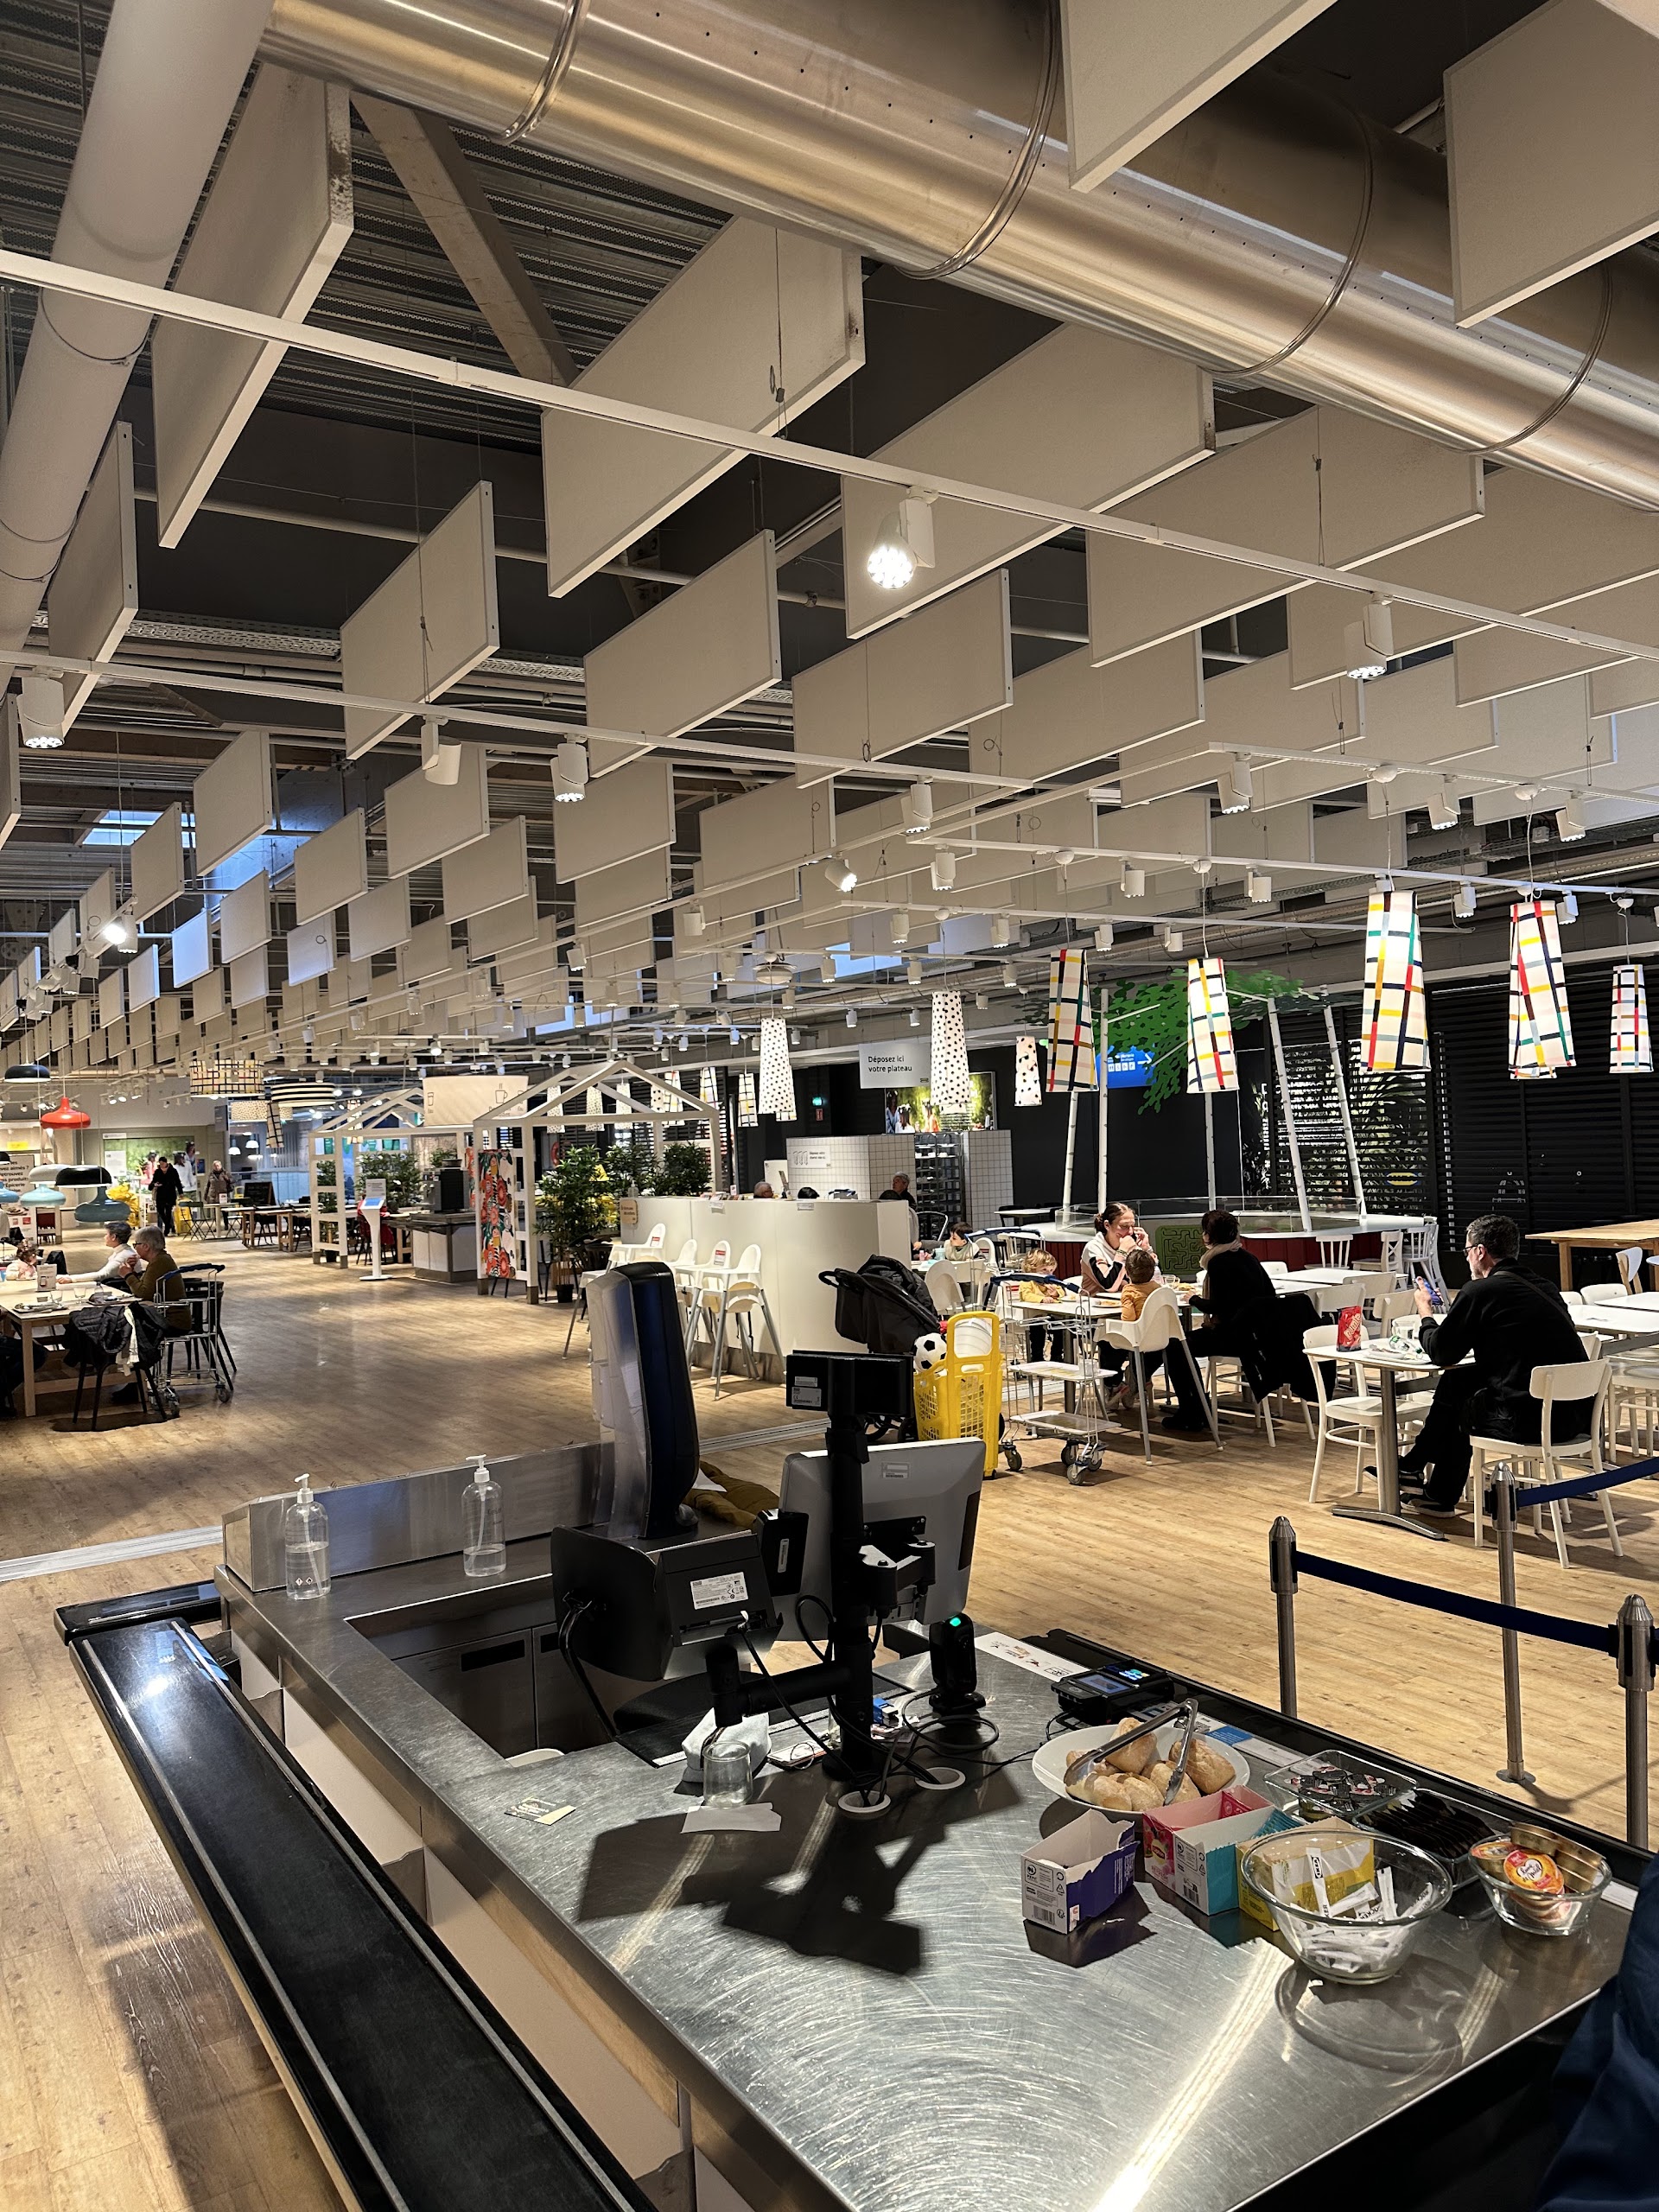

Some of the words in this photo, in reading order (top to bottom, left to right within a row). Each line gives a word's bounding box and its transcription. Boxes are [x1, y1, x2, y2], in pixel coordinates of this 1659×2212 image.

[868, 1055, 895, 1065] Déposez
[887, 1065, 912, 1073] plateau
[1313, 1858, 1322, 1878] IKEA
